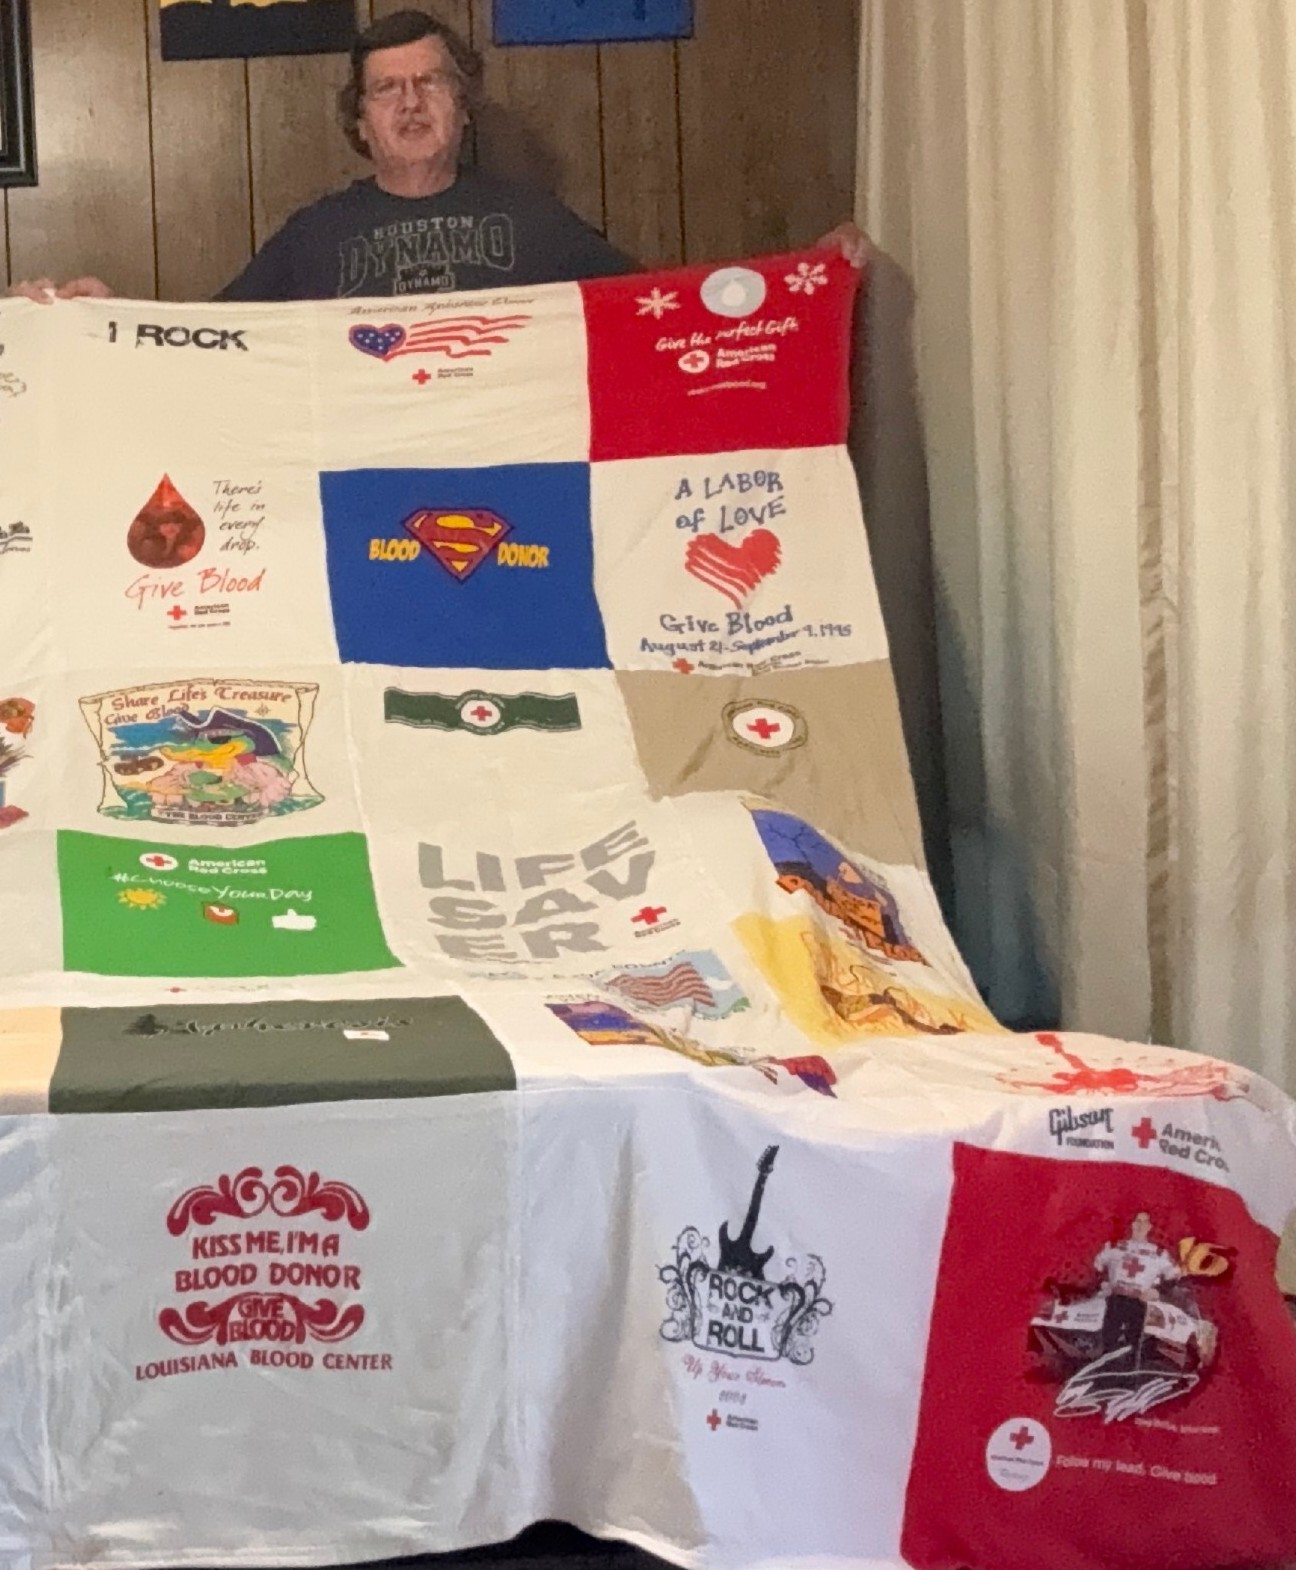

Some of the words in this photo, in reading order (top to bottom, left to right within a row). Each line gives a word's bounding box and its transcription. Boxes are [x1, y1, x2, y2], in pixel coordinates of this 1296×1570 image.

[373, 216, 474, 240] HOUSTON
[337, 213, 514, 298] DYNAMO
[109, 321, 118, 343] I
[135, 324, 250, 352] ROCK
[213, 480, 262, 496] There's
[674, 478, 693, 500] A
[703, 470, 783, 499] LABOR
[214, 499, 241, 519] life
[250, 501, 266, 512] in
[675, 508, 706, 532] of
[719, 495, 786, 534] LOVE
[219, 516, 266, 540] every
[219, 536, 261, 556] drop.
[369, 539, 421, 561] BLOOD
[497, 542, 550, 568] DONOR
[124, 574, 184, 611] Give
[197, 567, 267, 594] Blood
[659, 613, 720, 634] Give
[725, 604, 794, 636] Blood
[639, 637, 707, 657] August
[111, 693, 159, 712] Share
[168, 687, 208, 702] Life's
[214, 686, 293, 704] Treasure
[104, 713, 138, 726] Give
[145, 704, 190, 721] Blood
[188, 857, 267, 868] American
[417, 820, 650, 892] LIFE
[188, 866, 220, 875] Red
[220, 866, 268, 875] Cross
[427, 850, 657, 931] SAV
[435, 921, 610, 959] ER
[1048, 1105, 1114, 1146] Gibson
[1159, 1139, 1191, 1160] Red
[192, 1233, 242, 1260] KISS
[322, 1234, 340, 1257] A
[175, 1263, 257, 1293] BLOOD
[268, 1262, 361, 1291] DONOR
[708, 1272, 774, 1307] ROCK
[237, 1299, 284, 1318] GIVE
[722, 1302, 754, 1324] AND
[229, 1318, 295, 1342] BLOOD
[708, 1320, 765, 1353] ROLL
[135, 1350, 238, 1382] LOUISIANA
[249, 1349, 314, 1370] BLOOD
[322, 1353, 394, 1371] CENTER
[1150, 1465, 1182, 1482] Give
